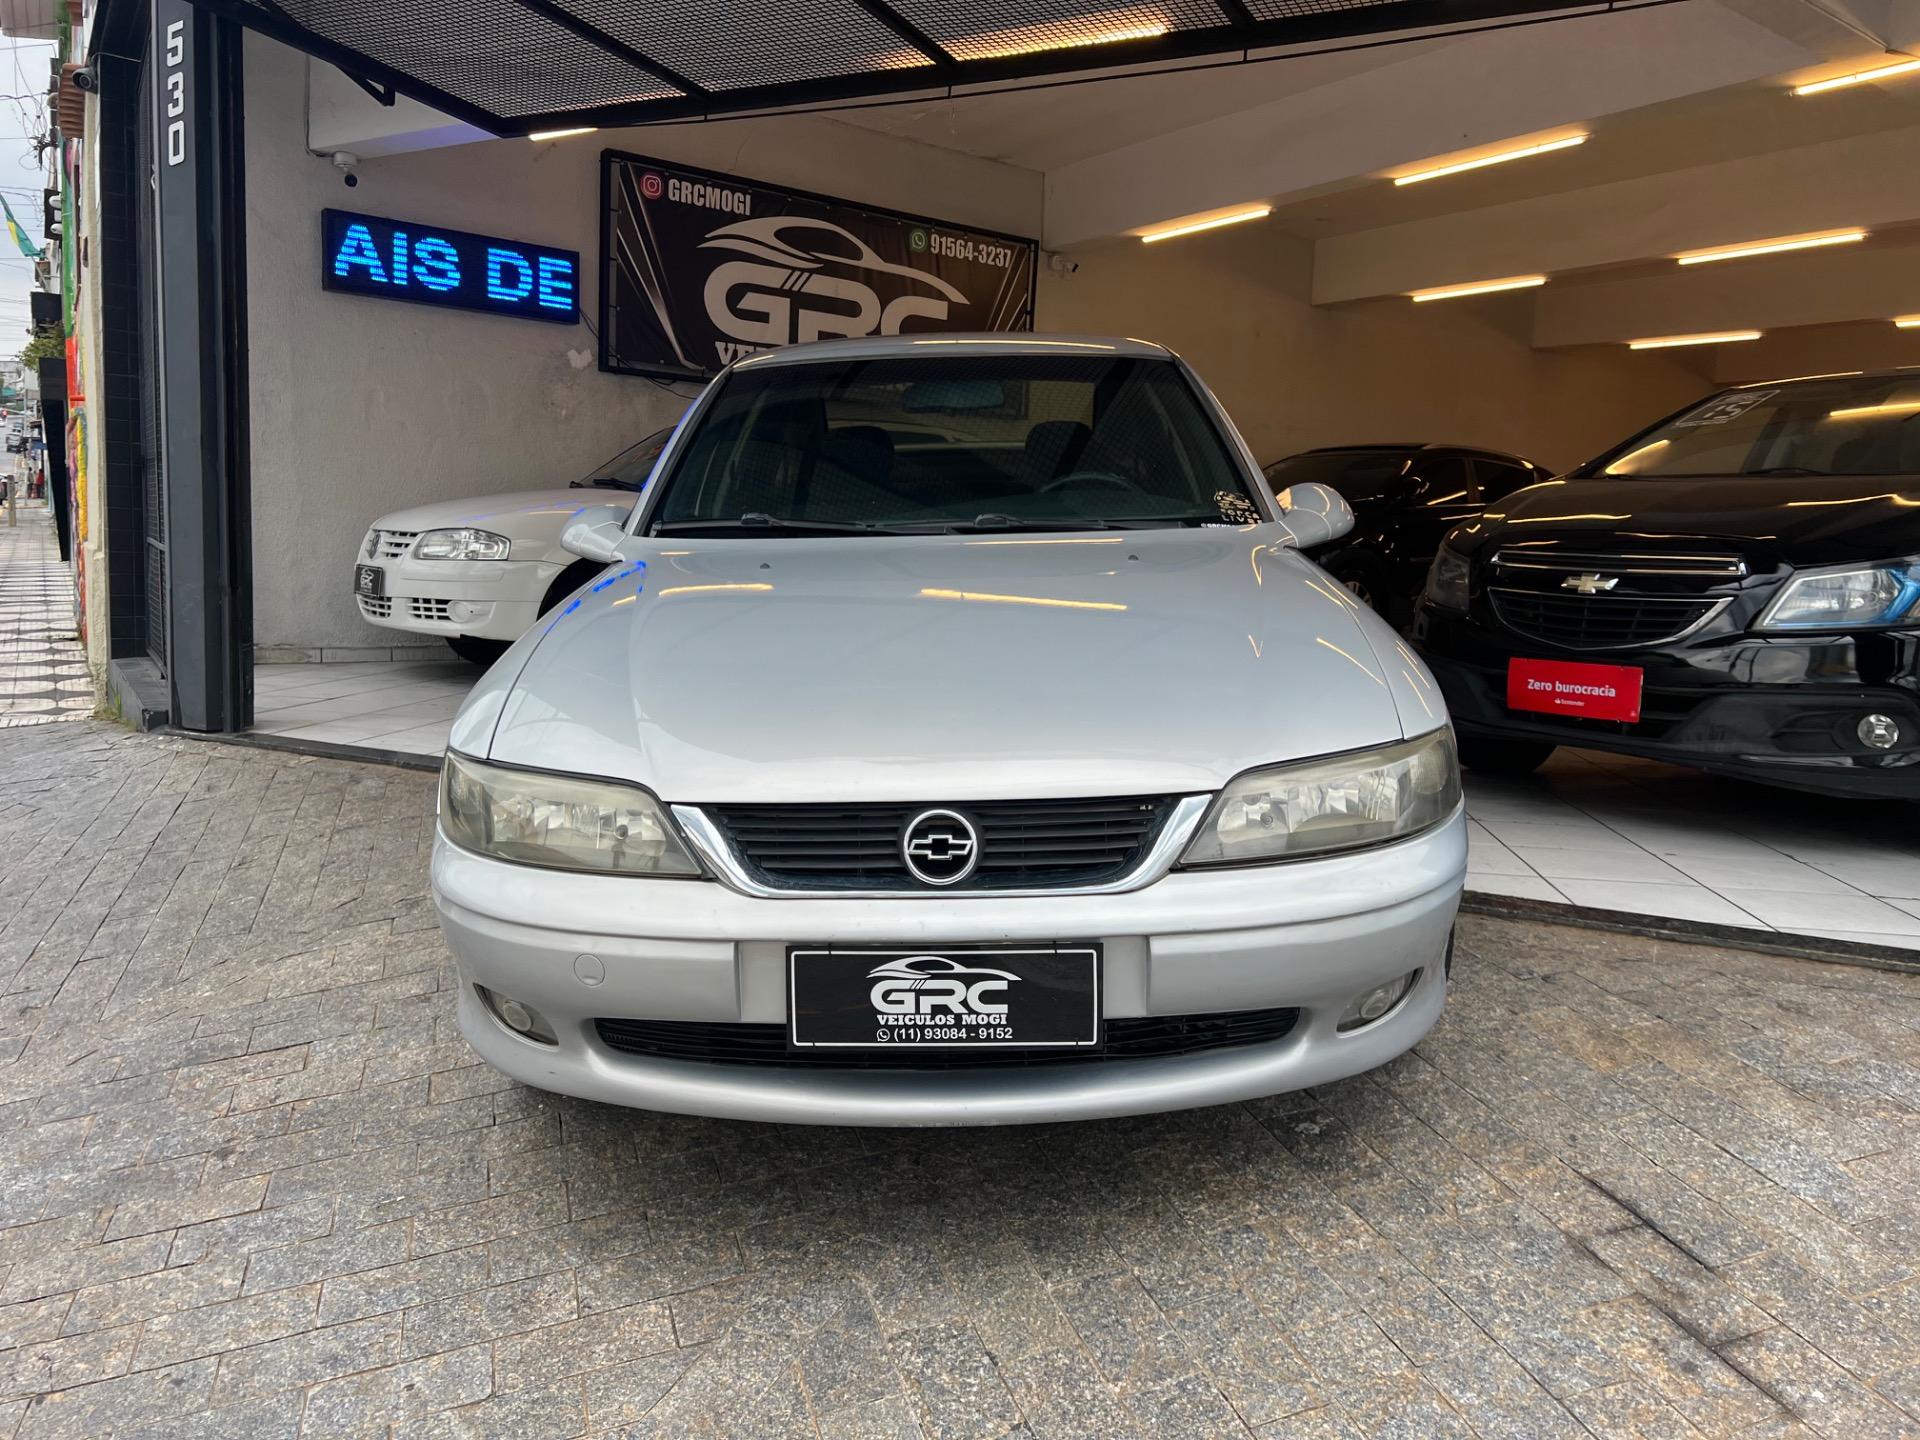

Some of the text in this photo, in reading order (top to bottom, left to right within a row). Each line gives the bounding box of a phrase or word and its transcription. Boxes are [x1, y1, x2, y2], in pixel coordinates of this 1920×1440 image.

[166, 19, 185, 166] 530
[667, 178, 752, 216] GRCMOGI
[334, 223, 573, 310] AIS DE
[930, 233, 1013, 269] 91564-3237
[703, 260, 948, 346] GRC
[1527, 678, 1616, 697] Zero burocracia
[870, 979, 1009, 1014] GRC
[877, 1014, 1008, 1025] VEICULOS MOGI
[893, 1027, 921, 1041] (11)
[924, 1027, 967, 1040] 93084
[979, 1027, 1014, 1039] 9152
